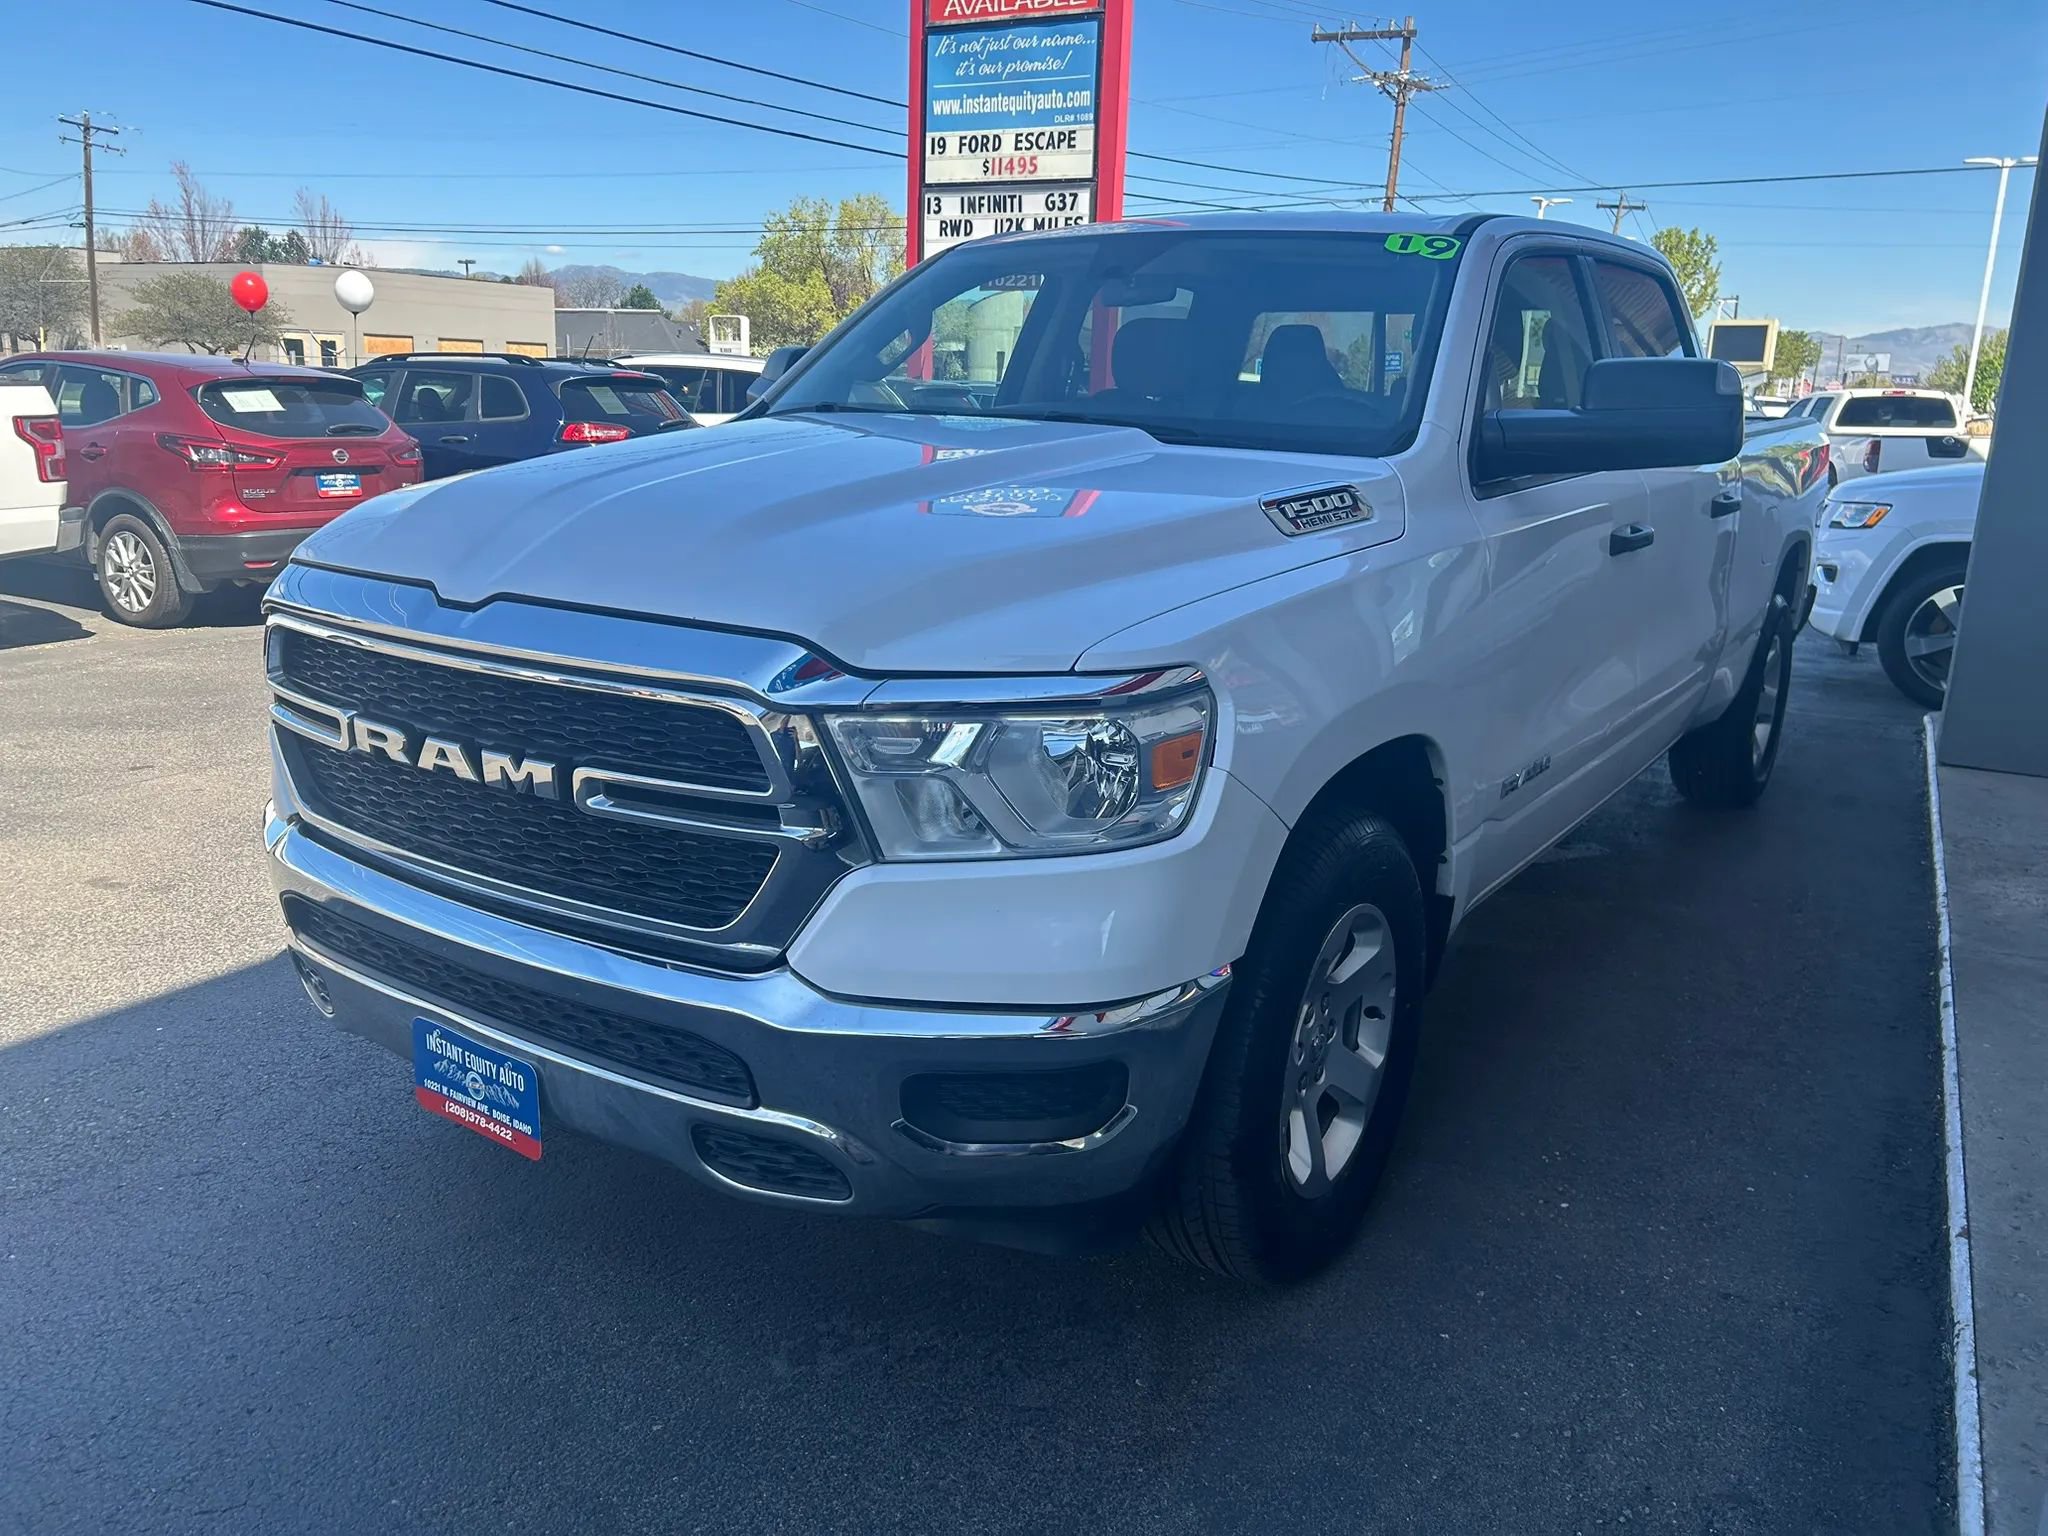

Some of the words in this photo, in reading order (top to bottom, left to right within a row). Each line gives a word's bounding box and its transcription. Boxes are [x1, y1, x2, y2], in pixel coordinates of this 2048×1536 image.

[943, 0, 1087, 16] AVAIL
[935, 35, 956, 57] It's
[959, 36, 986, 54] not
[978, 34, 1014, 60] just
[1013, 35, 1039, 50] our
[1041, 33, 1095, 48] name...
[955, 57, 976, 77] it's
[979, 61, 1003, 76] our
[1002, 50, 1073, 80] promise!
[933, 89, 1091, 116] www.instantequityauto.com
[1054, 114, 1075, 123] DLR#
[930, 136, 947, 155] 19
[958, 134, 1002, 154] FORD
[1014, 130, 1077, 151] ESCAPE
[982, 156, 1038, 176] $11495
[926, 197, 942, 214] 13
[960, 195, 1023, 214] INFINITI
[1045, 193, 1079, 212] G37
[939, 219, 974, 237] RWD
[994, 218, 1025, 234] 112K
[1395, 234, 1458, 258] 19
[1280, 491, 1354, 518] 1500
[1300, 514, 1333, 529] HEMI
[1333, 510, 1358, 521] 5.7L
[353, 716, 559, 800] RAM
[426, 1033, 463, 1065] INSTANT
[464, 1052, 497, 1080] EQUITY
[499, 1066, 525, 1092] AUTO
[423, 1078, 441, 1093] 10221
[449, 1089, 477, 1109] FAIRVIEW
[492, 1109, 512, 1128] BOISE,
[512, 1118, 532, 1136] IDAHO
